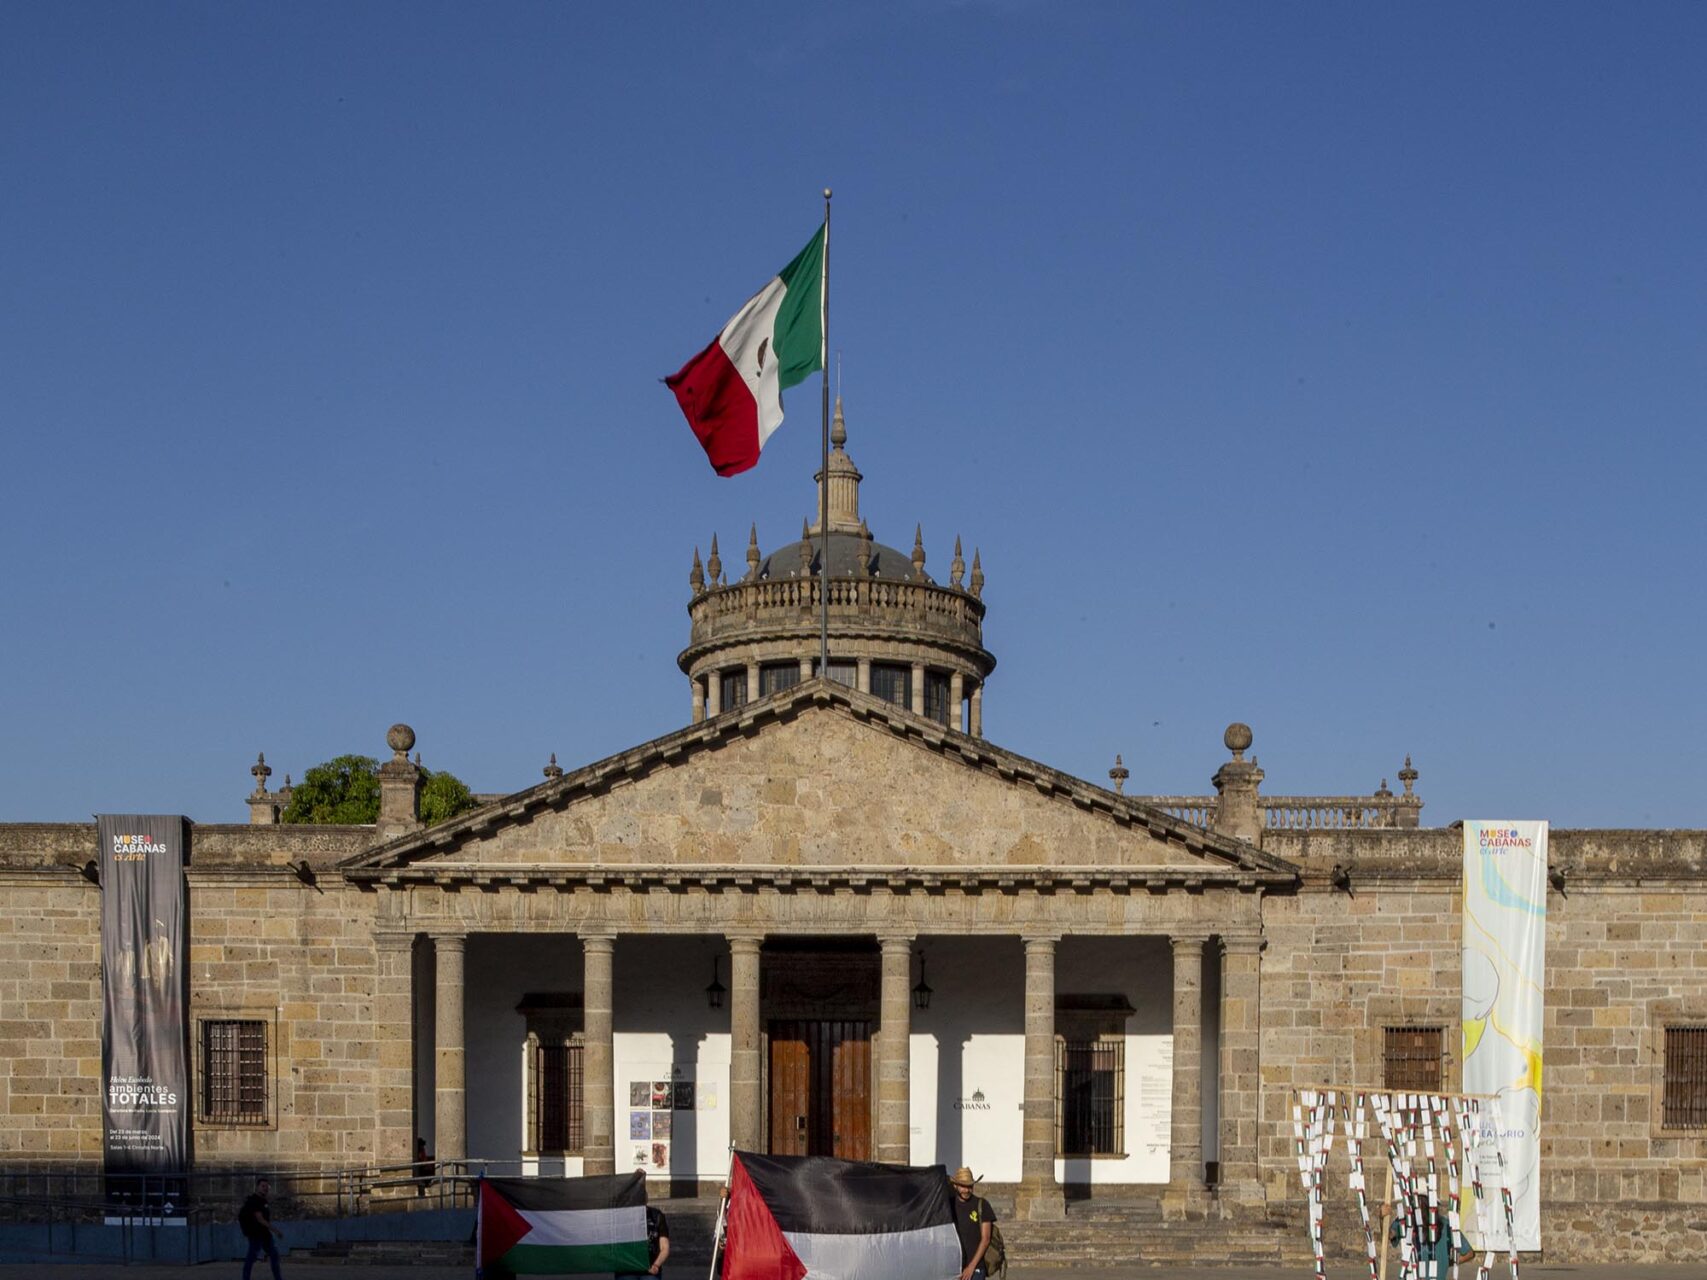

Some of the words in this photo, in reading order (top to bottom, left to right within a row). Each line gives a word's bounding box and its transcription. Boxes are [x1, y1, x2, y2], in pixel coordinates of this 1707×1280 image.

[1480, 829, 1518, 838] MUSEO
[114, 835, 152, 844] MUSEO
[109, 1084, 169, 1094] ambientes
[109, 1093, 177, 1105] TOTALES
